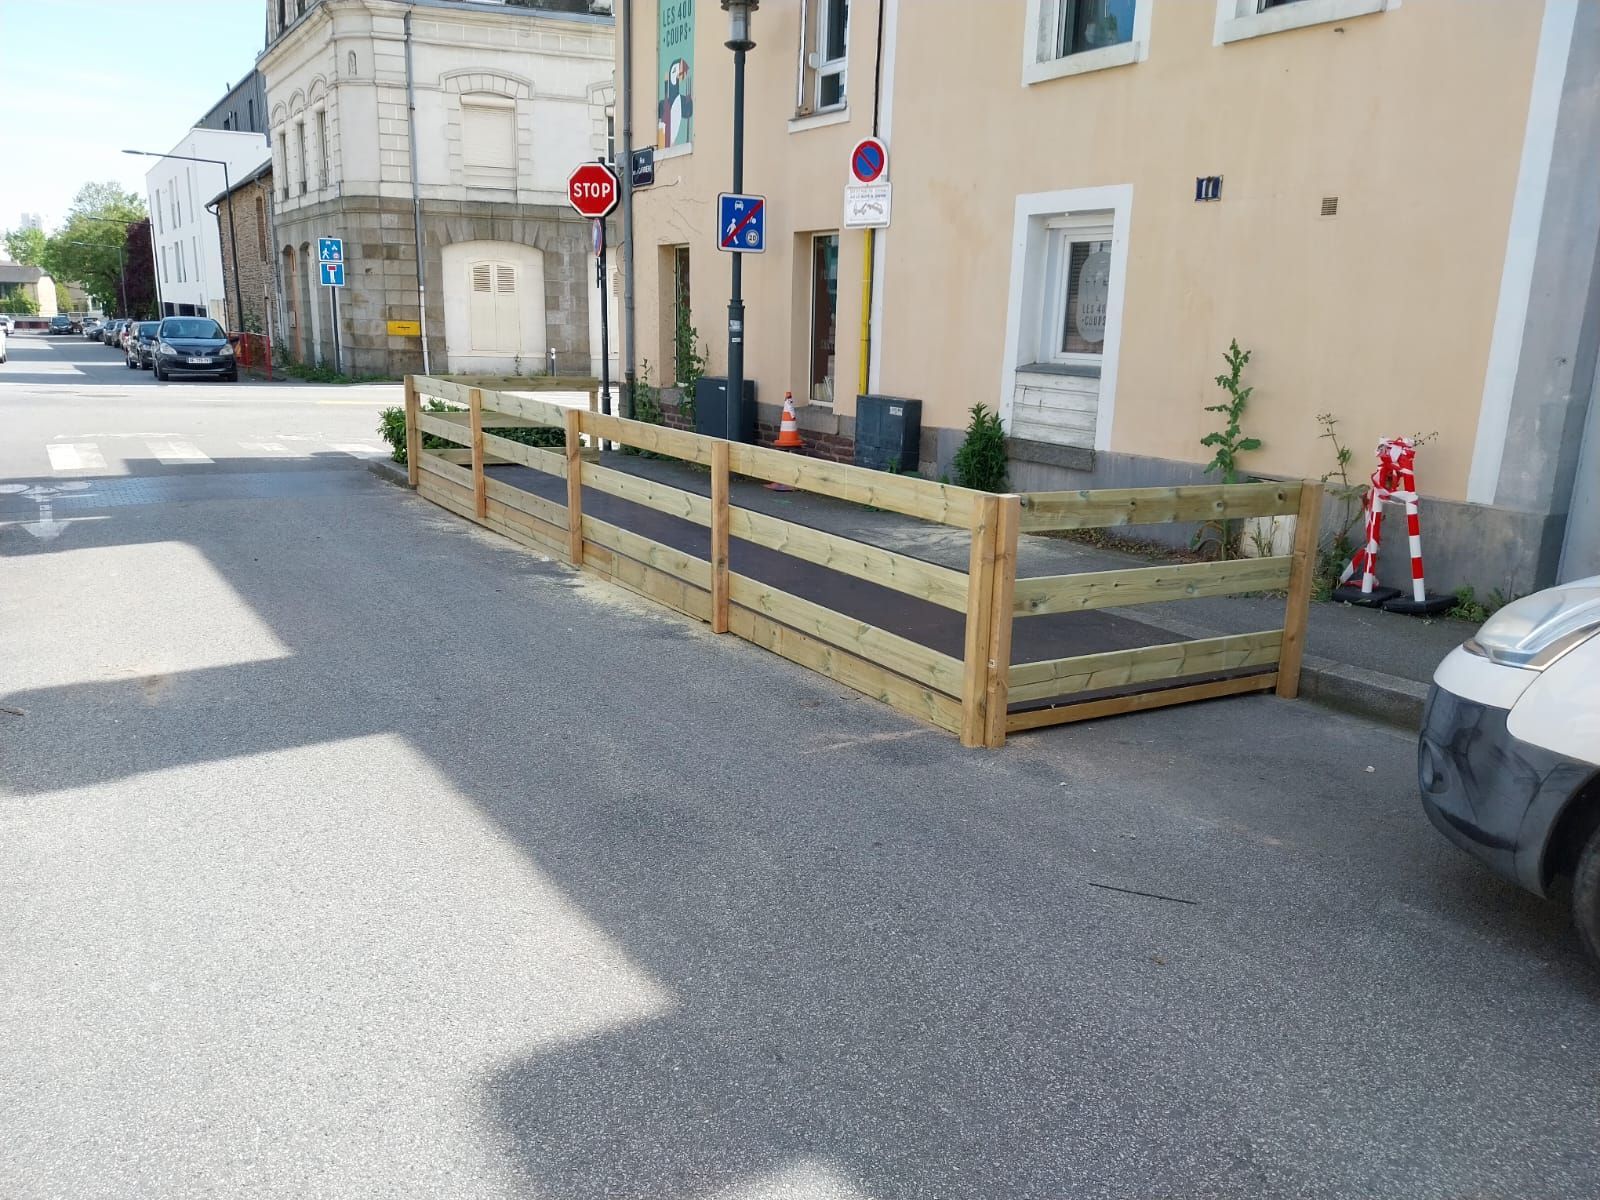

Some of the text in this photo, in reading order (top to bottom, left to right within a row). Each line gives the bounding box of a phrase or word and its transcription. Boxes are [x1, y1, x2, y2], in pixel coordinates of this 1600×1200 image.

[662, 0, 692, 28] LES 400
[573, 182, 612, 198] STOP
[1201, 180, 1214, 199] 11
